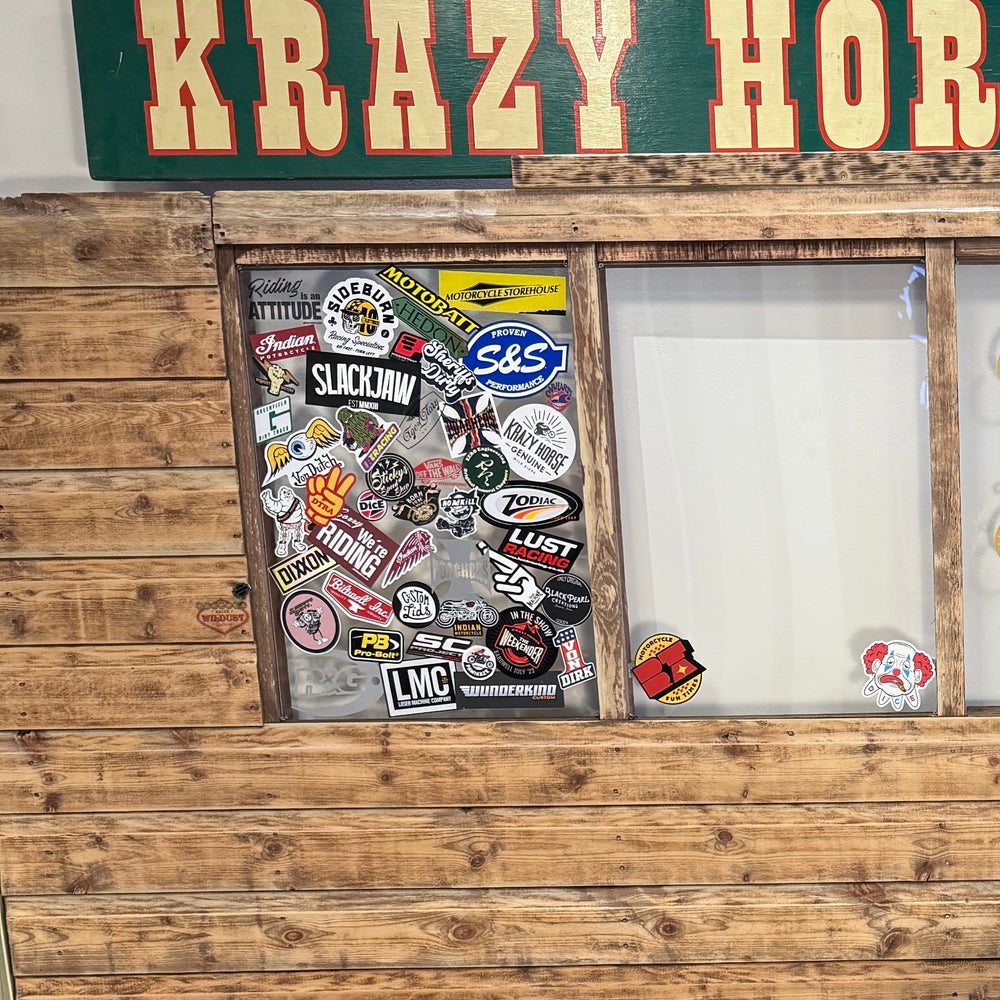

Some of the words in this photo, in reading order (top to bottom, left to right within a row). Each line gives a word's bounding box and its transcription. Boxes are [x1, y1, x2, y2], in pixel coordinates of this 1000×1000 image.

[137, 0, 637, 155] KRAZY
[248, 277, 303, 298] Riding
[301, 292, 308, 300] is
[445, 288, 502, 301] MOTORCYCLE
[503, 284, 559, 298] STOREHOUSE
[248, 301, 323, 320] ATTITUDE
[327, 281, 395, 324] SIDEBURN
[383, 266, 480, 334] MOTOBATT
[400, 303, 462, 352] HEDON
[491, 327, 528, 340] PROVEN
[256, 334, 316, 353] Indian
[259, 346, 316, 360] MOTORCYCLE
[473, 342, 549, 376] S&S
[312, 362, 417, 406] SLACKJAW
[485, 374, 545, 392] PERFORMANCE
[503, 418, 539, 450] KRAZY
[534, 442, 569, 475] HORSE
[424, 461, 443, 470] VANS
[510, 445, 546, 473] GENUINE
[428, 468, 443, 479] THE
[311, 497, 334, 516] DTRA
[502, 494, 557, 517] ZODIAC
[316, 523, 382, 580] RIDING
[508, 527, 578, 558] LUST
[278, 548, 331, 586] DIXXON
[503, 542, 570, 570] RACING
[454, 623, 482, 632] INDIAN
[510, 610, 520, 620] IN
[520, 610, 534, 622] THE
[534, 616, 554, 638] SHOW
[361, 632, 390, 651] PB
[498, 628, 545, 665] WEEKENDER
[638, 636, 674, 661] MOTORCYCLE
[353, 649, 397, 660] Pro-Bolt
[392, 665, 450, 701] LMC
[561, 667, 594, 688] DIRK
[459, 684, 557, 698] WUNDERKIND
[665, 694, 682, 703] FUN
[682, 678, 699, 701] TIMES
